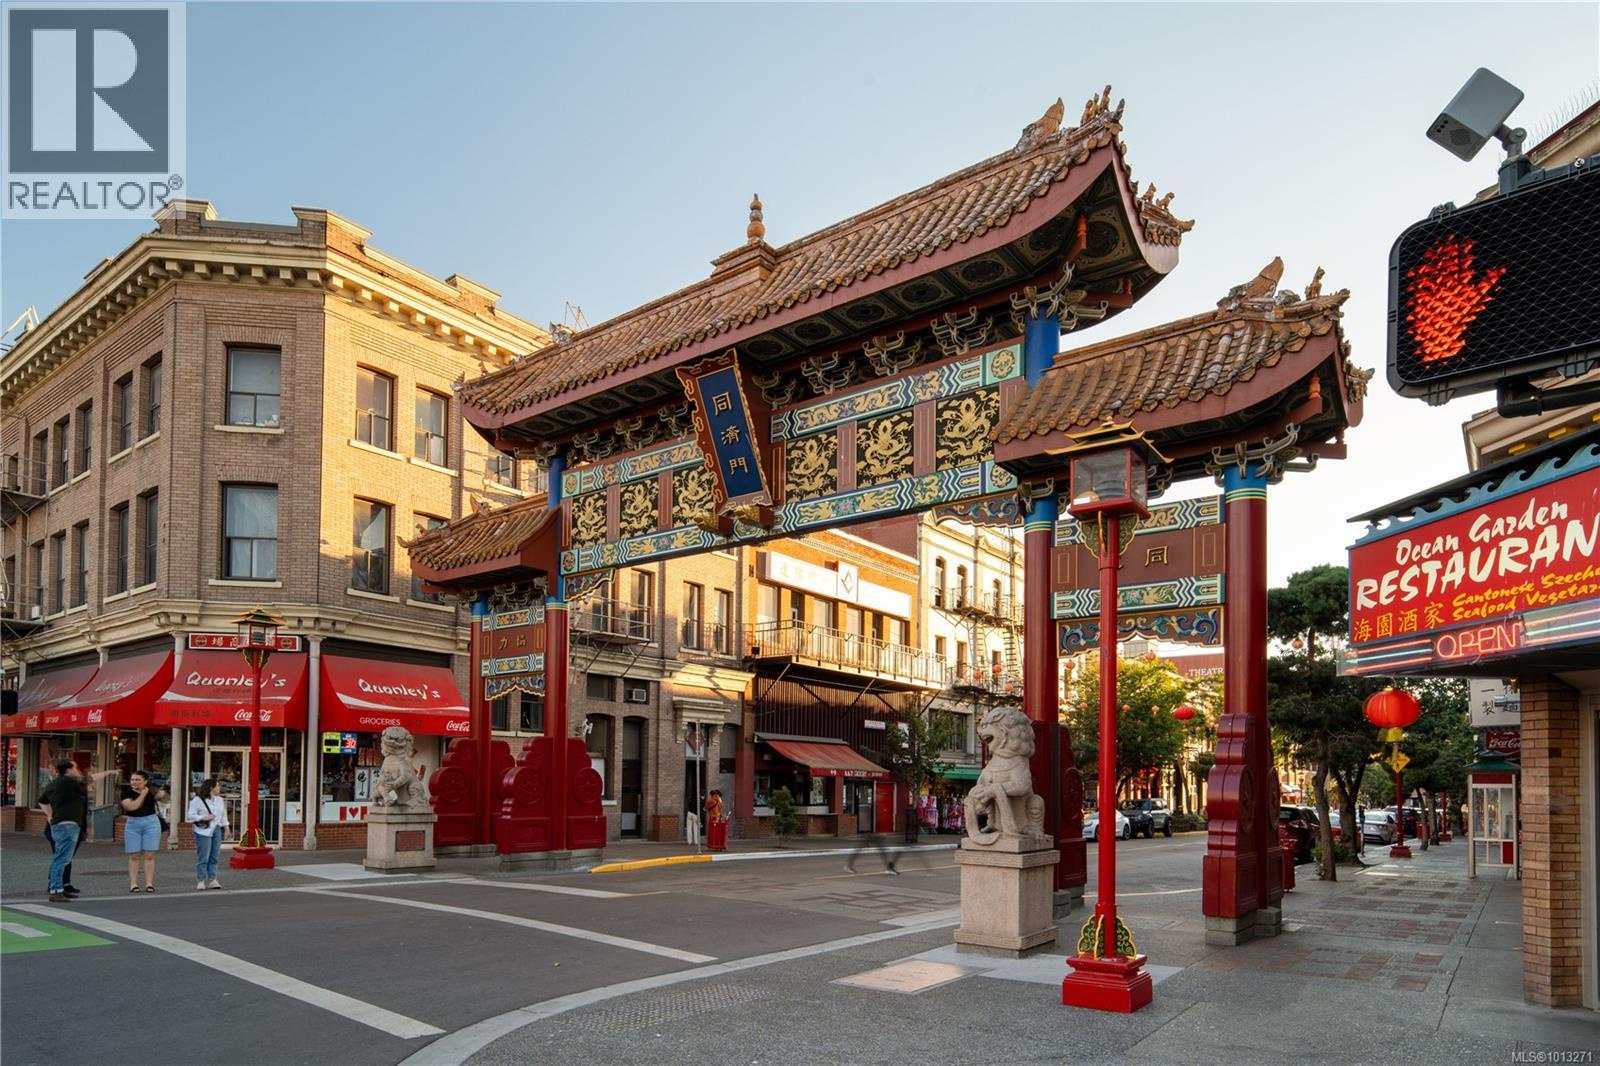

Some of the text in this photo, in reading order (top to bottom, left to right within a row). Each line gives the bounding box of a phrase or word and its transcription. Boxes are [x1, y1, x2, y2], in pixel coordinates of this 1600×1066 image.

[1396, 498, 1568, 565] Ocean Garden
[1356, 512, 1600, 611] RESTAURAN
[1452, 581, 1535, 607] Cantonese
[1452, 582, 1600, 622] Seafood Vegetar
[1354, 601, 1446, 643] 海園酒家
[1437, 621, 1523, 659] OPEN
[358, 678, 441, 700] Quanley's
[1188, 667, 1224, 678] THEATR
[360, 716, 401, 726] GROCERIES
